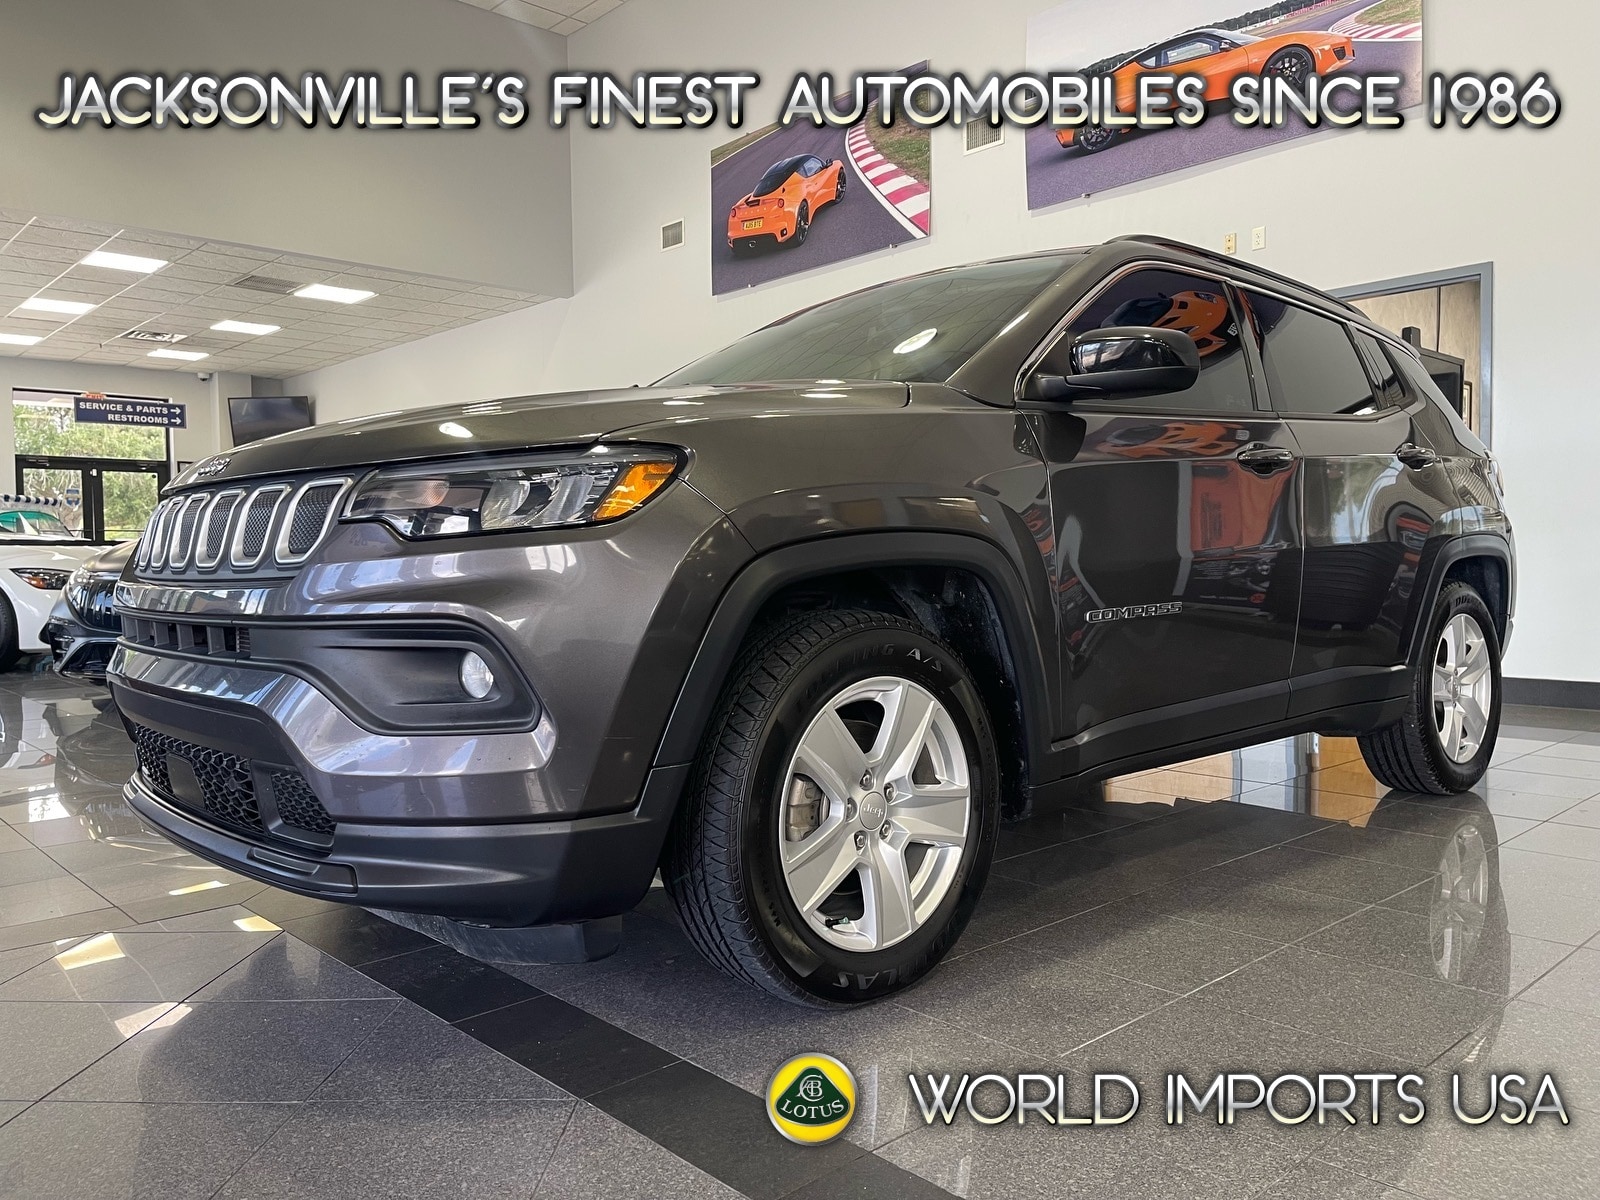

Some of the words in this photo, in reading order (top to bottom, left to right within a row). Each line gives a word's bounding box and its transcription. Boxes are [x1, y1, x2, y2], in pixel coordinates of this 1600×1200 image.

[79, 402, 123, 411] SERVICE
[126, 404, 133, 412] &
[136, 405, 168, 414] PARTS
[107, 413, 169, 424] RESTROOMS
[1086, 602, 1182, 623] COMPASS
